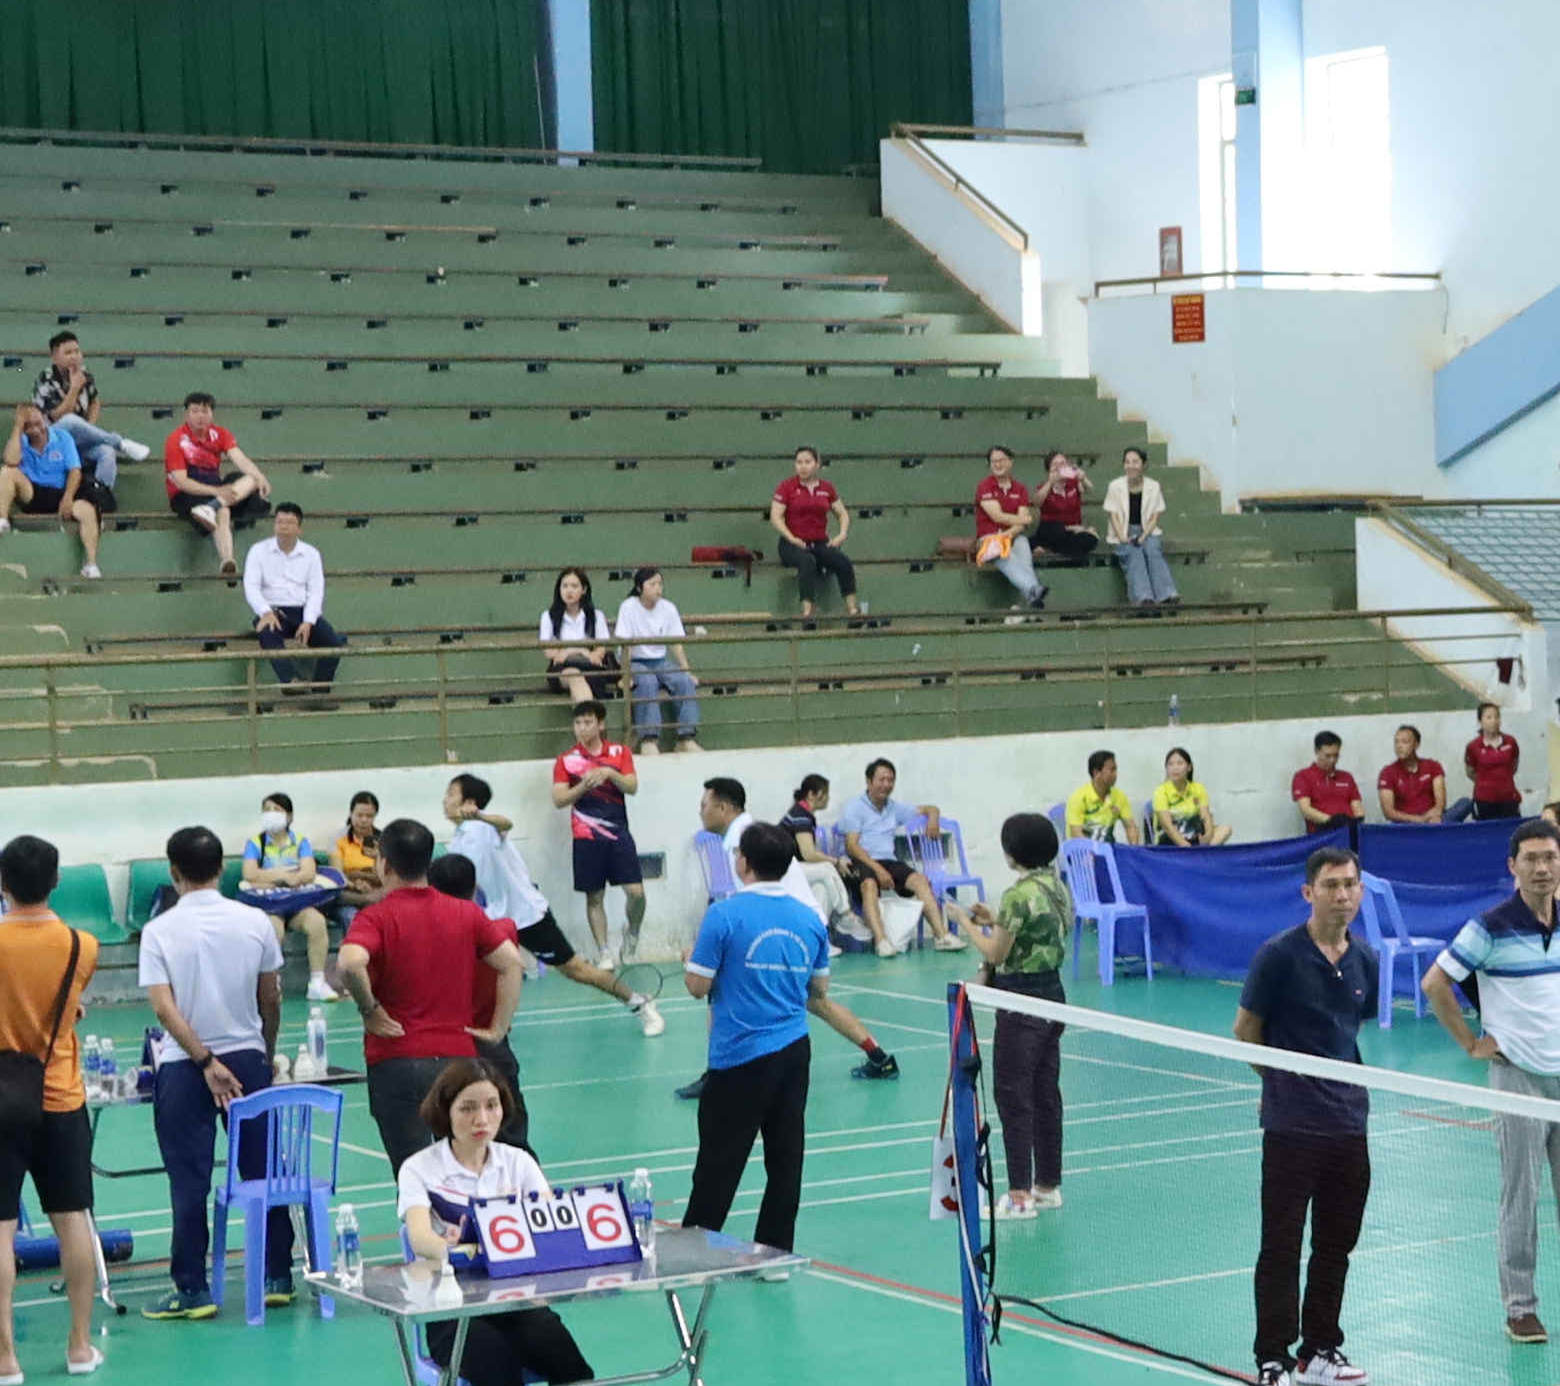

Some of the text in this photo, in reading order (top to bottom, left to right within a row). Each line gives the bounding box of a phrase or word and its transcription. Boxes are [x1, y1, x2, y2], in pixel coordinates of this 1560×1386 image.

[489, 1204, 622, 1254] 6 0 0 6
